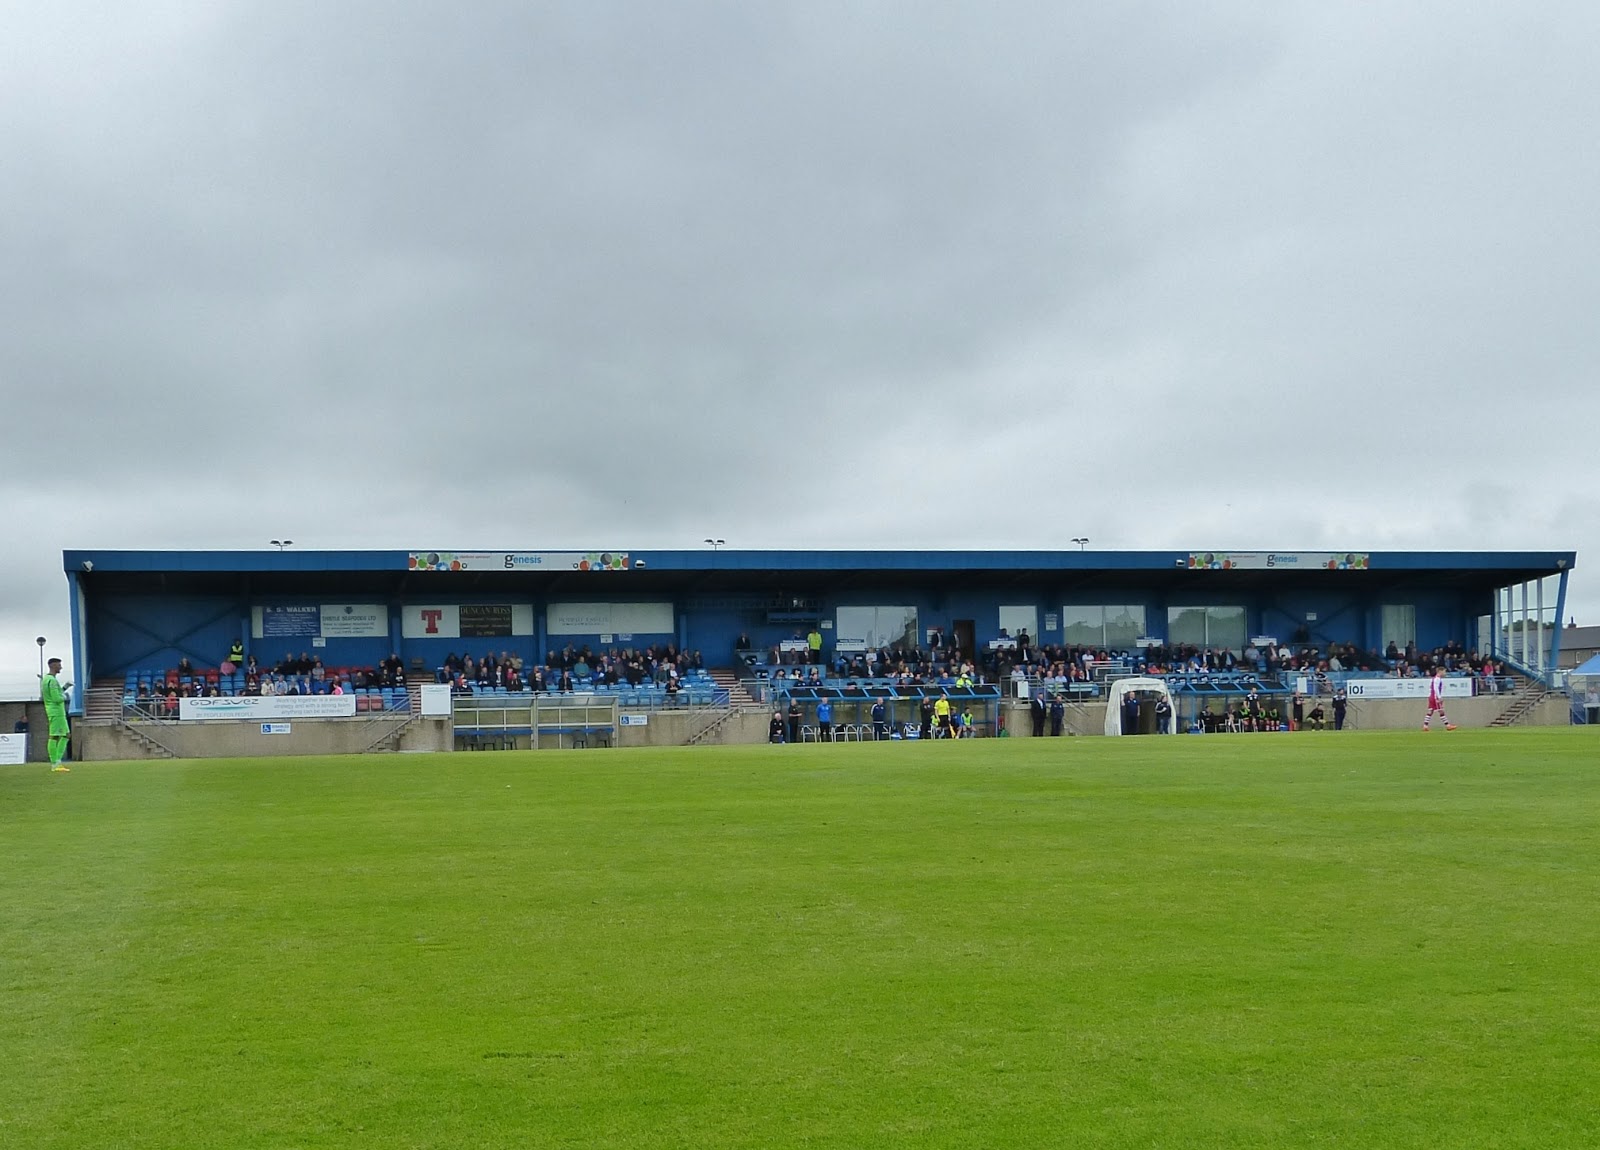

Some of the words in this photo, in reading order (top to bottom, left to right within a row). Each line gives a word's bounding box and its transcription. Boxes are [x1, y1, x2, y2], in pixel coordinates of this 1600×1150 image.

[504, 554, 542, 568] genesis
[1266, 554, 1298, 567] genesis
[460, 606, 490, 615] DUNCAN
[421, 609, 442, 634] T
[189, 698, 220, 706] GDF
